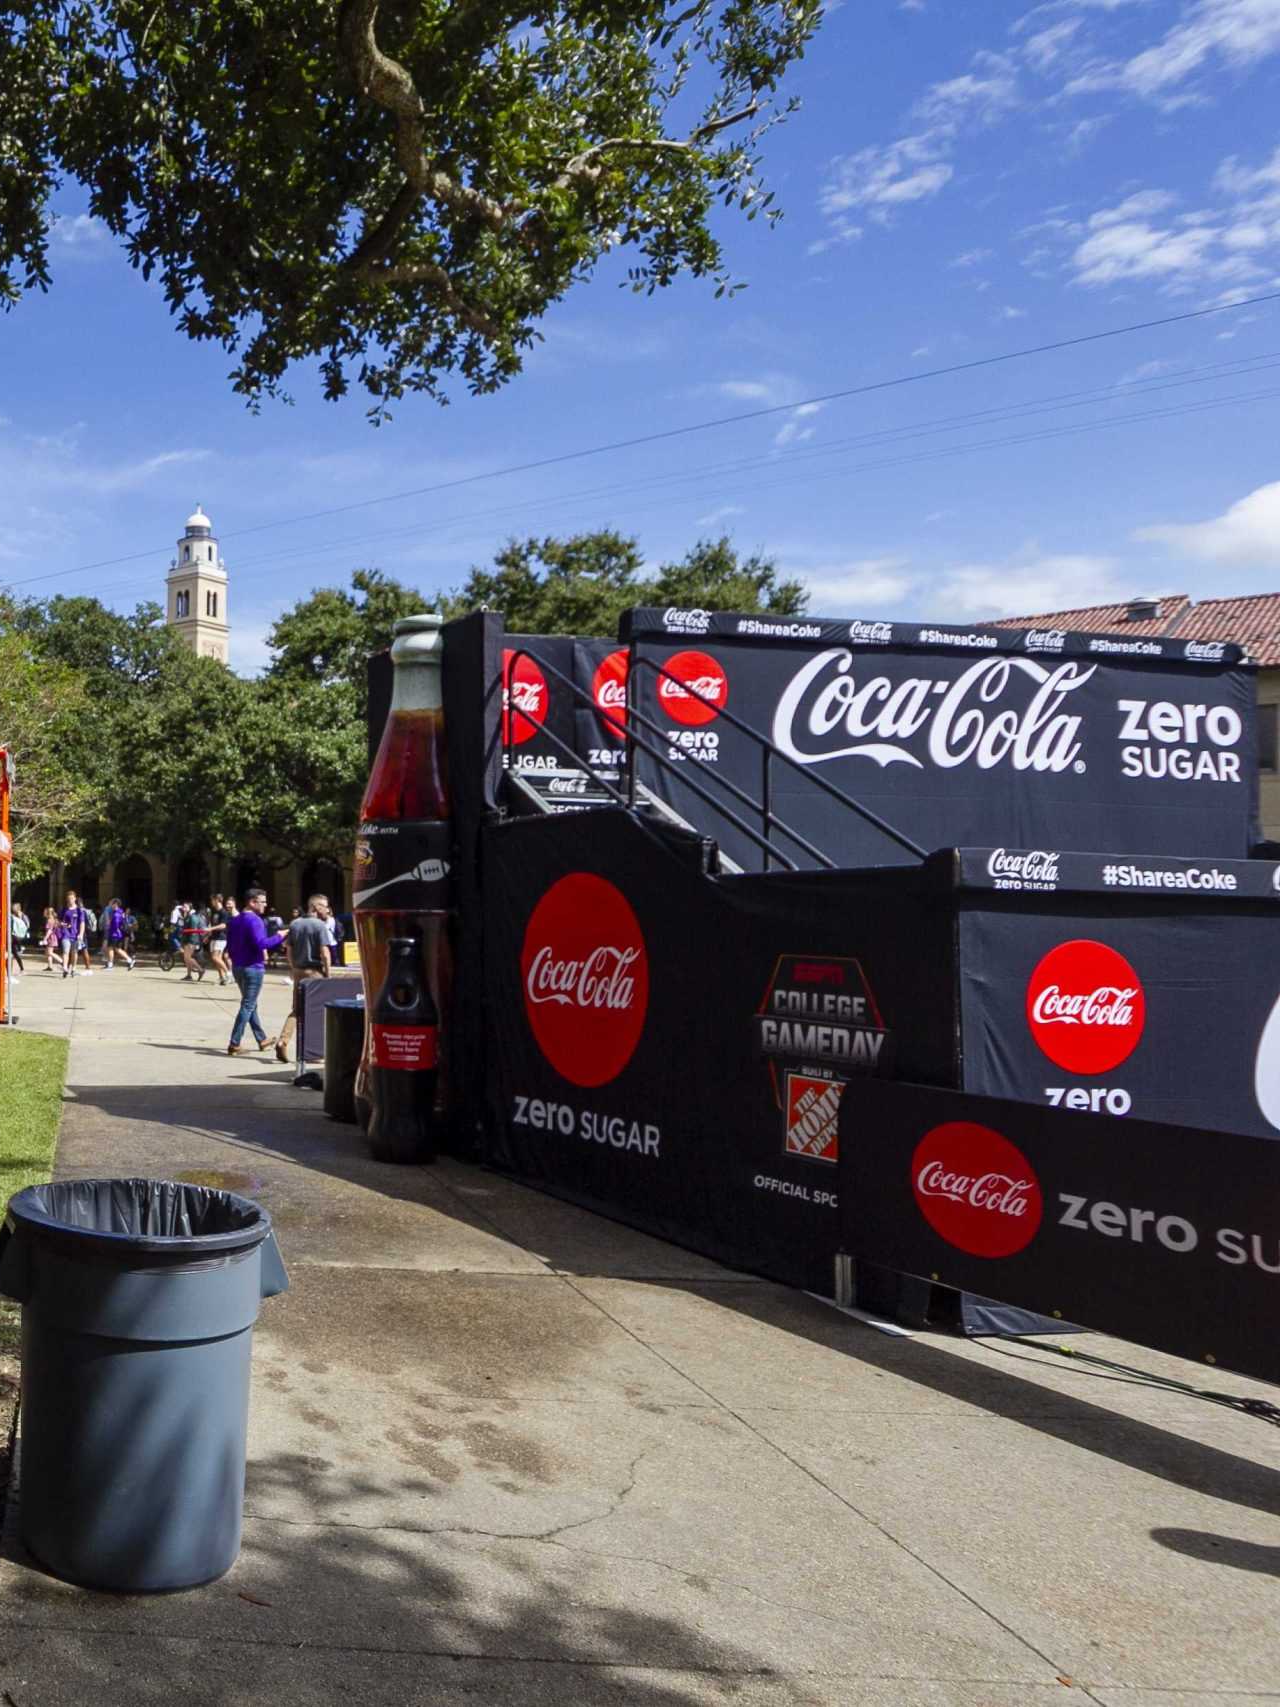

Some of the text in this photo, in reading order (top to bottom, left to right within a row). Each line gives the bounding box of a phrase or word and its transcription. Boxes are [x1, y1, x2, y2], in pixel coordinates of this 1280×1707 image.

[663, 607, 712, 628] Coca-Cola
[737, 619, 821, 638] #ShareaCoke
[850, 620, 893, 641] Coca-Cola
[919, 629, 998, 648] #ShareaCoke
[1024, 629, 1067, 648] Coca-Cola
[1089, 639, 1162, 655] #ShareaCoke
[1184, 640, 1226, 659] Coca-Cola
[772, 648, 1098, 774] Coca-Cola
[1118, 699, 1242, 747] zero
[668, 731, 719, 748] zero
[1122, 746, 1241, 783] SUGAR
[987, 848, 1060, 881] Coca-Cola
[1103, 864, 1237, 890] #ShareaCoke
[994, 879, 1022, 889] zero
[528, 945, 640, 1009] Coca-Cola
[773, 989, 866, 1021] COLLEGE
[1032, 984, 1138, 1026] Coca-Cola
[761, 1019, 885, 1066] GAMEDAY
[1044, 1087, 1132, 1116] zero
[513, 1095, 660, 1158] zero SUGAR
[754, 1175, 810, 1201] OFFICIAL
[918, 1161, 1033, 1217] Coca-Cola
[1058, 1192, 1197, 1253] zero
